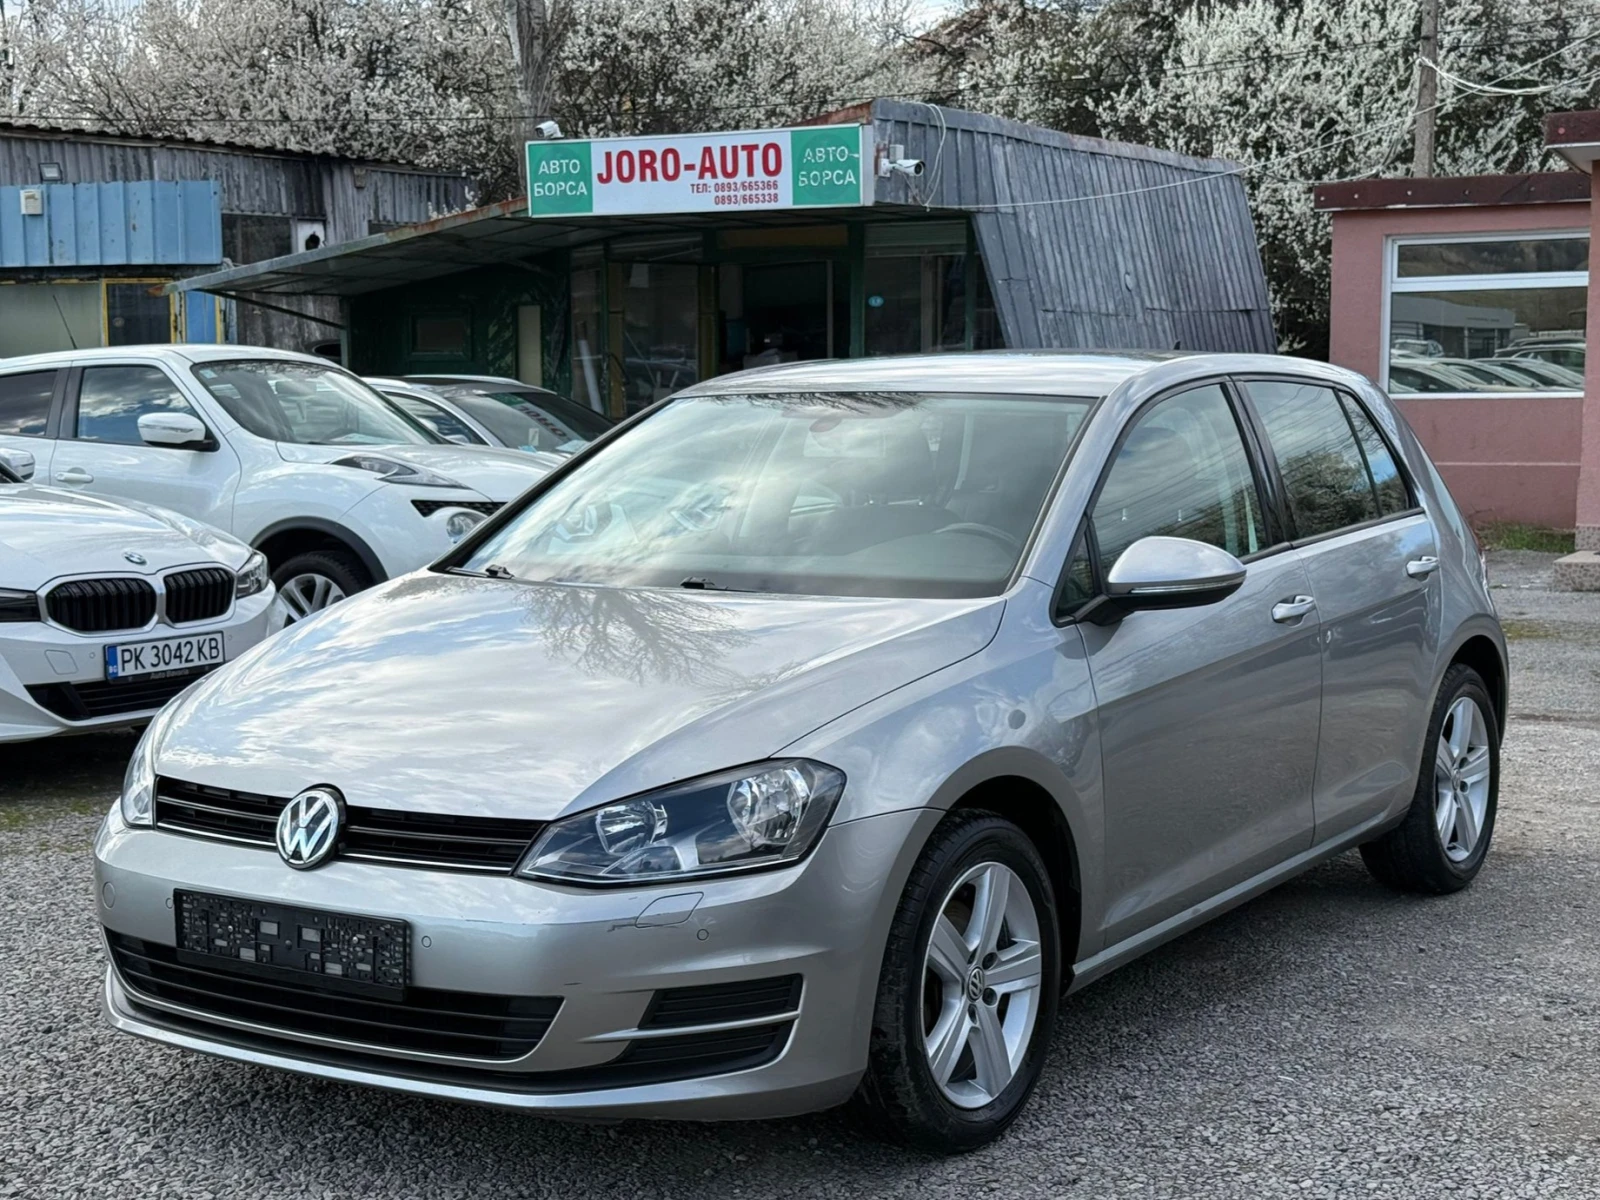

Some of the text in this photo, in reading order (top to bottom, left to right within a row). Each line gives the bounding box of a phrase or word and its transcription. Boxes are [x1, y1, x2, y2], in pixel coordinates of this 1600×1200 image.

[538, 159, 581, 175] АВТО
[597, 142, 783, 184] JORO-AUTO
[798, 169, 857, 187] БОРСА
[533, 181, 588, 197] БОРСА
[690, 180, 779, 194] ТЕЛ: 0893/665366
[714, 193, 779, 206] 0893/665338
